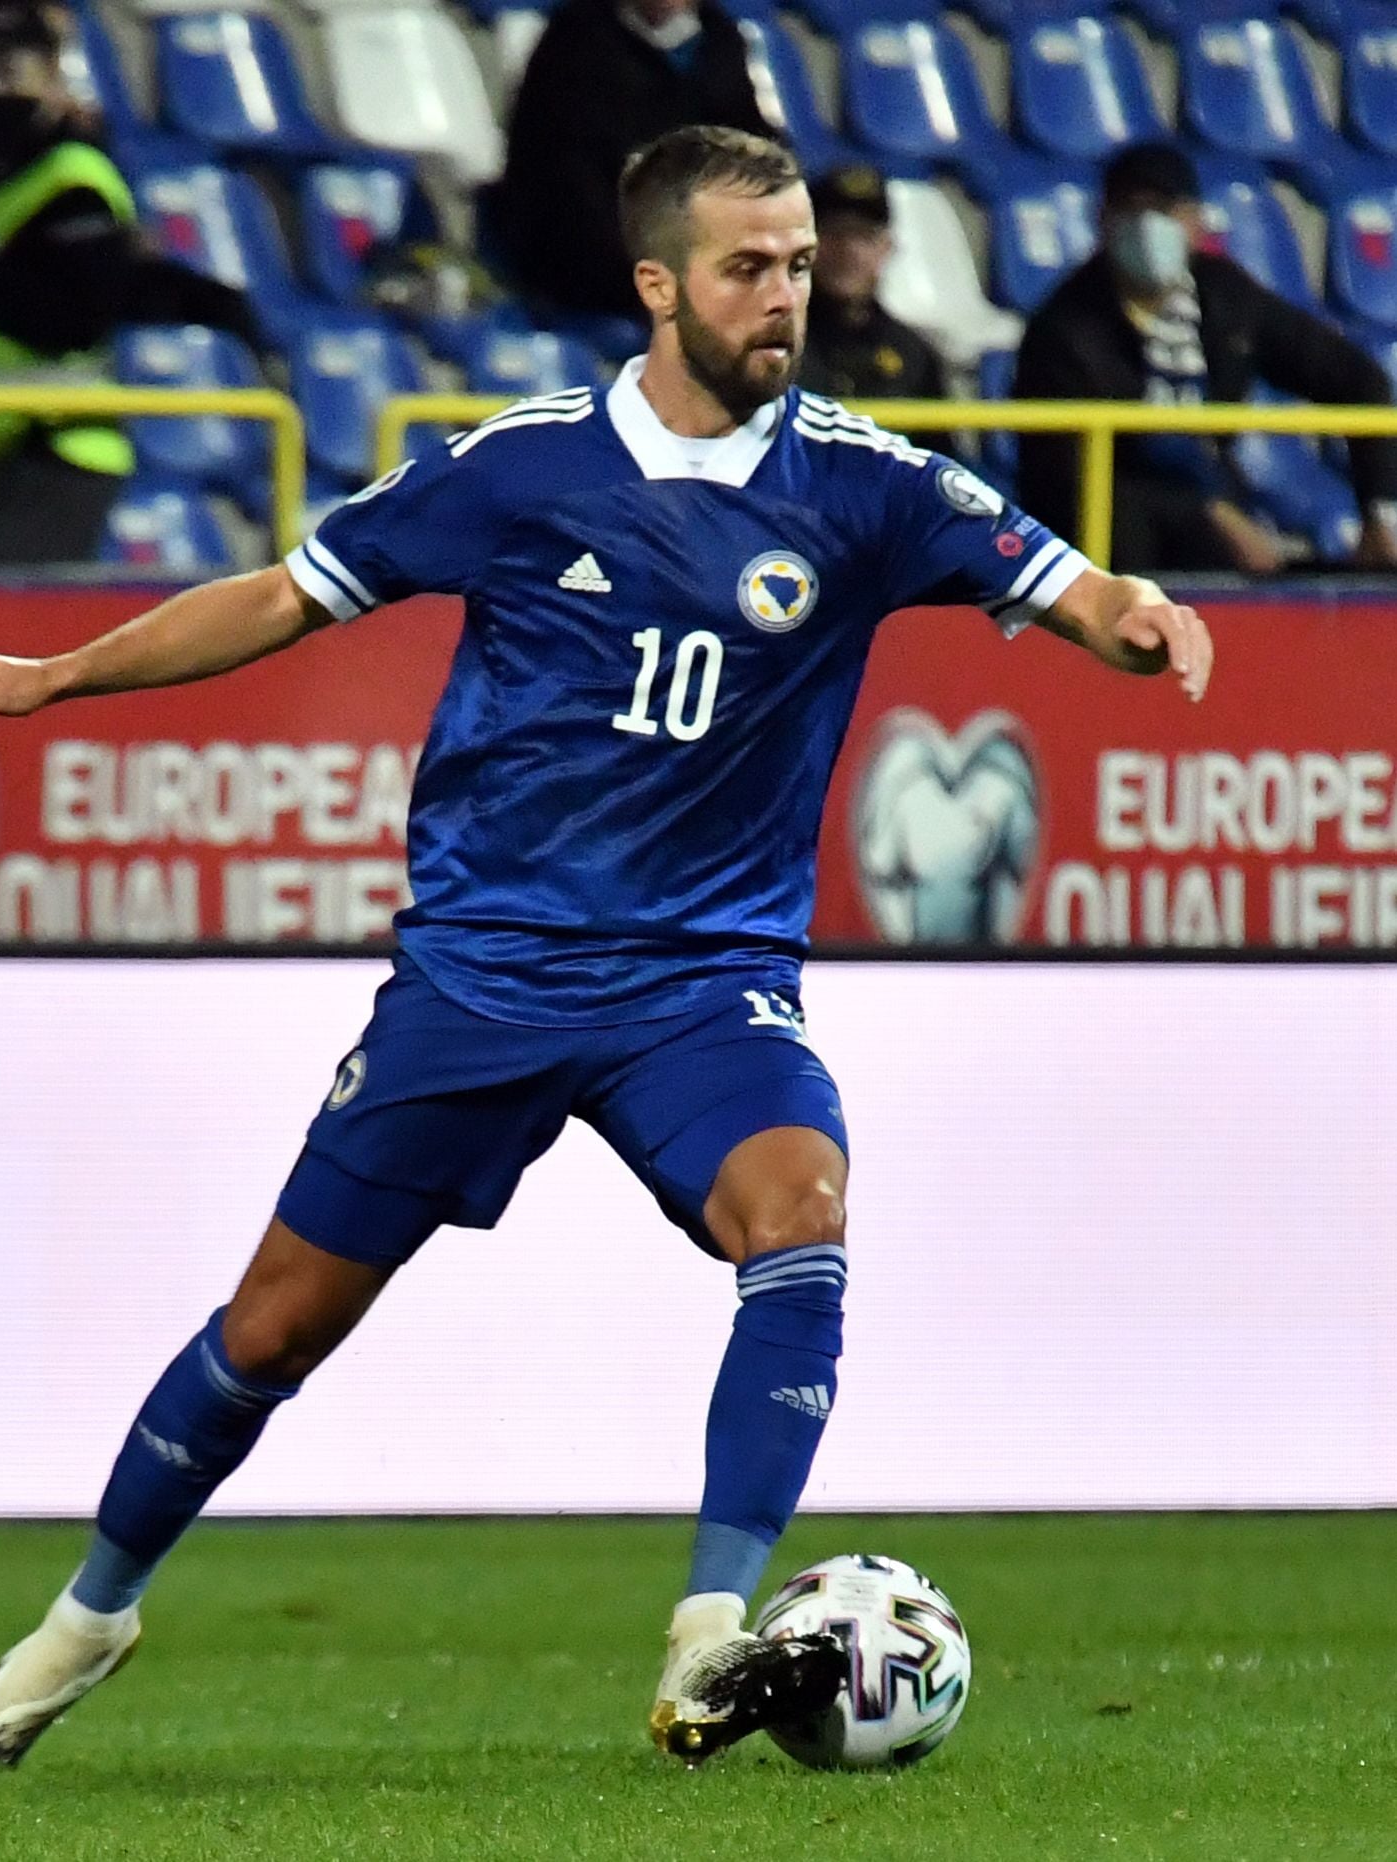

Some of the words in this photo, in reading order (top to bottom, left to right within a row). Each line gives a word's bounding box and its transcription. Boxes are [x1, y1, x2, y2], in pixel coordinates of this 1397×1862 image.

[612, 627, 724, 741] 10
[42, 738, 424, 846] EUROPEA
[1098, 749, 1397, 853] EUROPE
